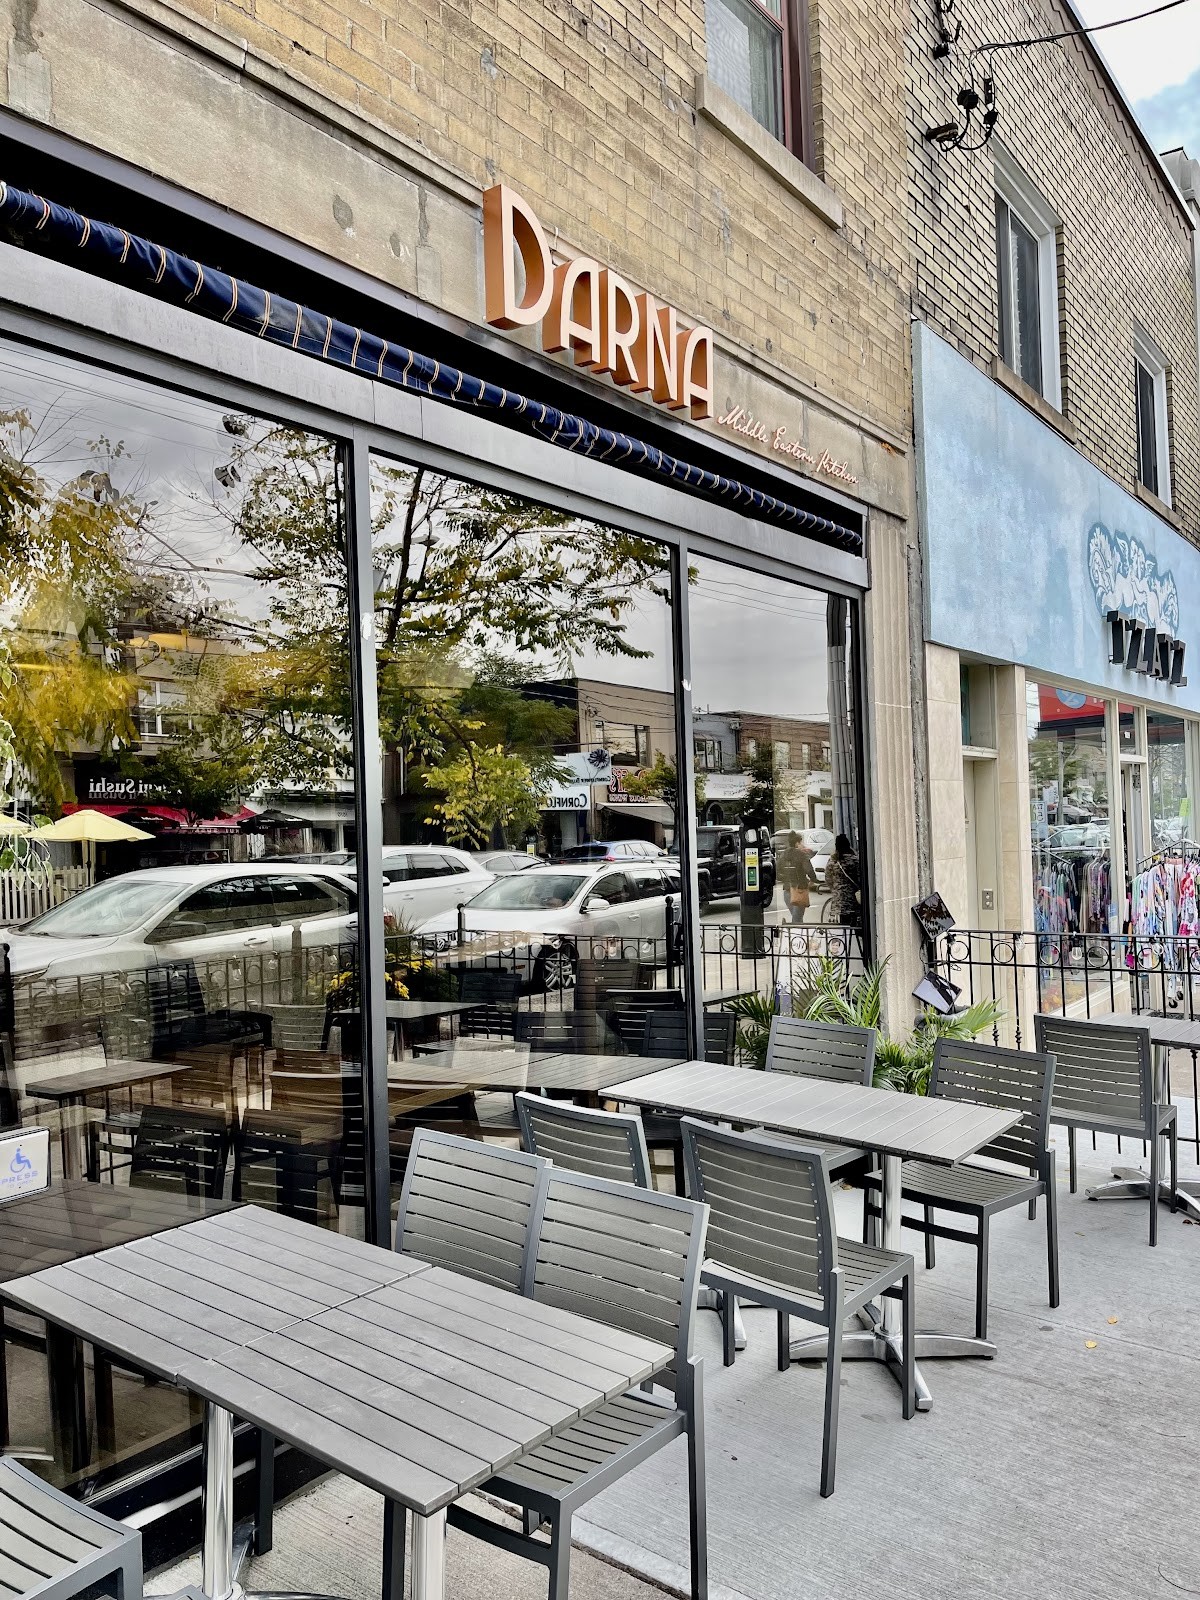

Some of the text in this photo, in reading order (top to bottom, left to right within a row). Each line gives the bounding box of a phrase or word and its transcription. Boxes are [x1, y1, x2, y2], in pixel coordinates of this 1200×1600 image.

[484, 184, 714, 421] DARNA
[717, 405, 860, 485] Middle Eastern Kitchen
[1, 1170, 39, 1185] PRESS
